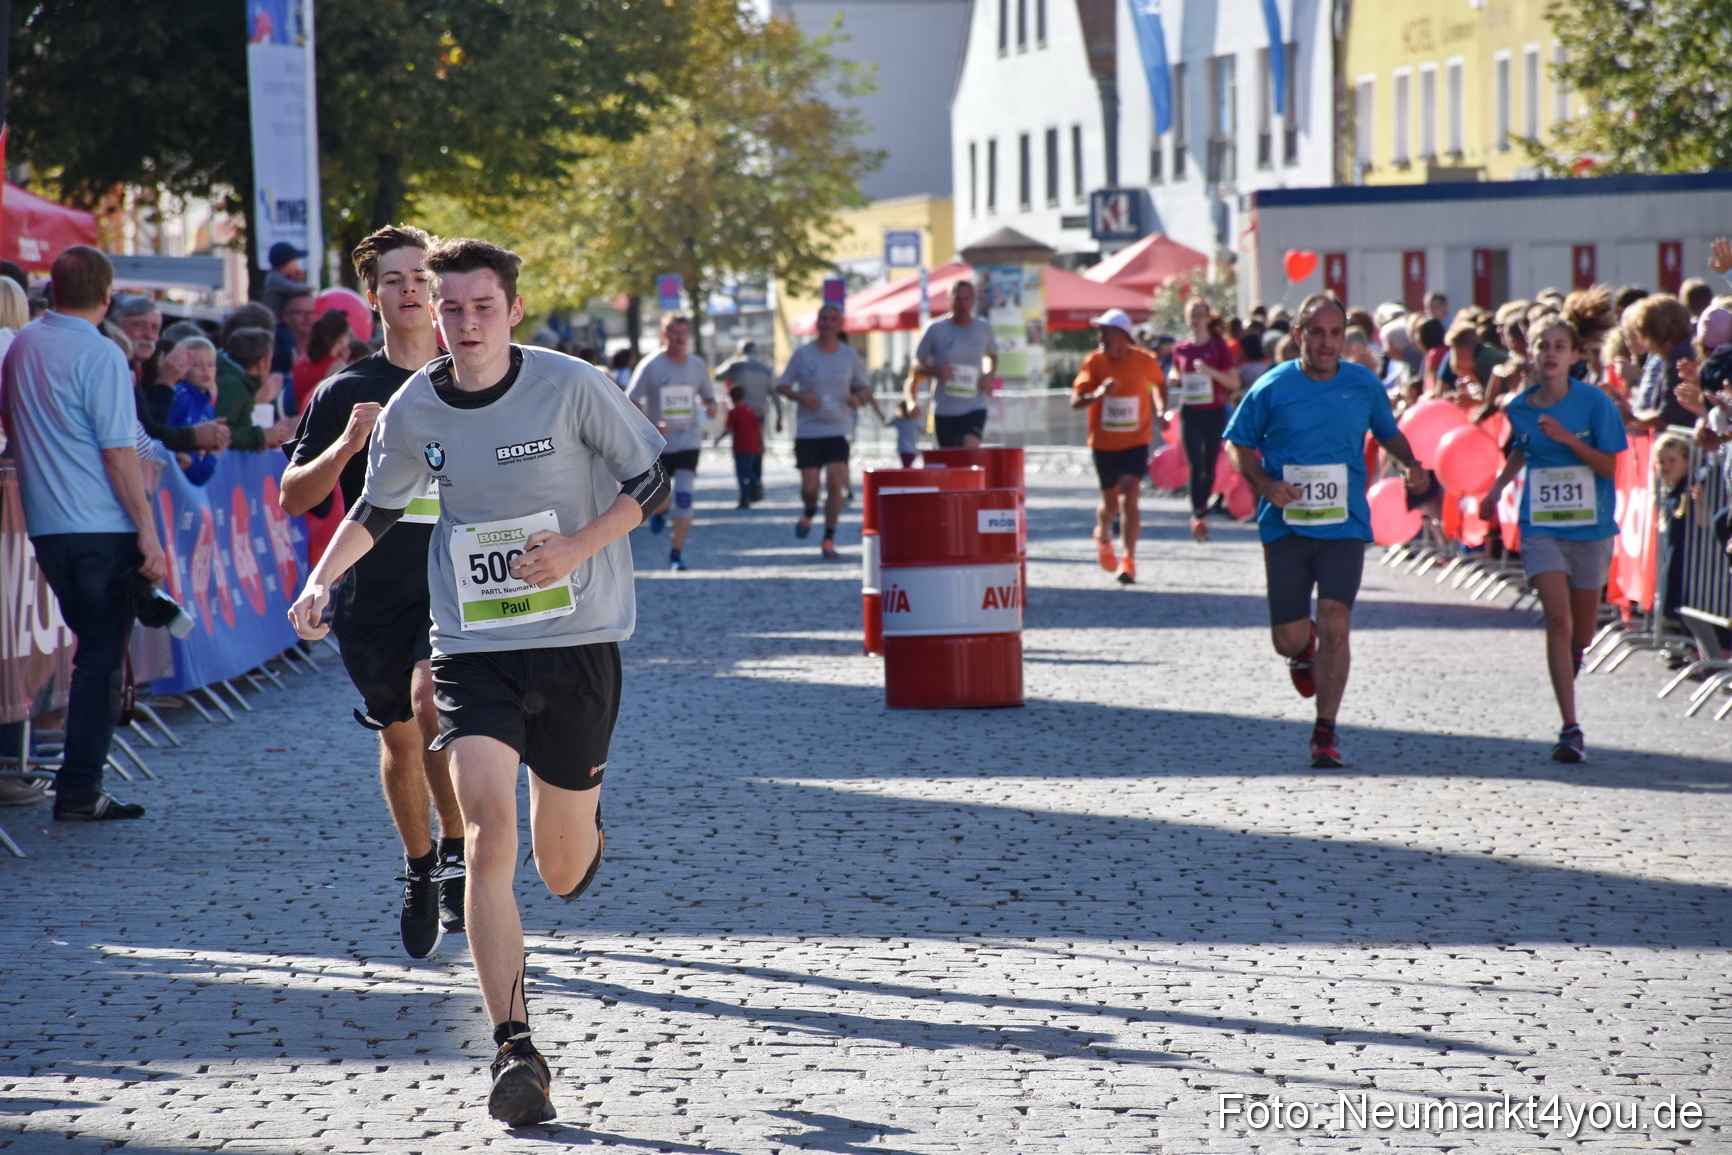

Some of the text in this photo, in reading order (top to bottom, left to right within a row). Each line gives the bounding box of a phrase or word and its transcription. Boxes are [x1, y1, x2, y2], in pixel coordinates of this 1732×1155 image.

[496, 438, 553, 460] BOCK
[1540, 483, 1583, 502] 5131
[477, 528, 525, 543] BOCK
[481, 583, 537, 596] PARTL Neumarkt
[982, 580, 1018, 610] AVI
[501, 598, 531, 615] Paul
